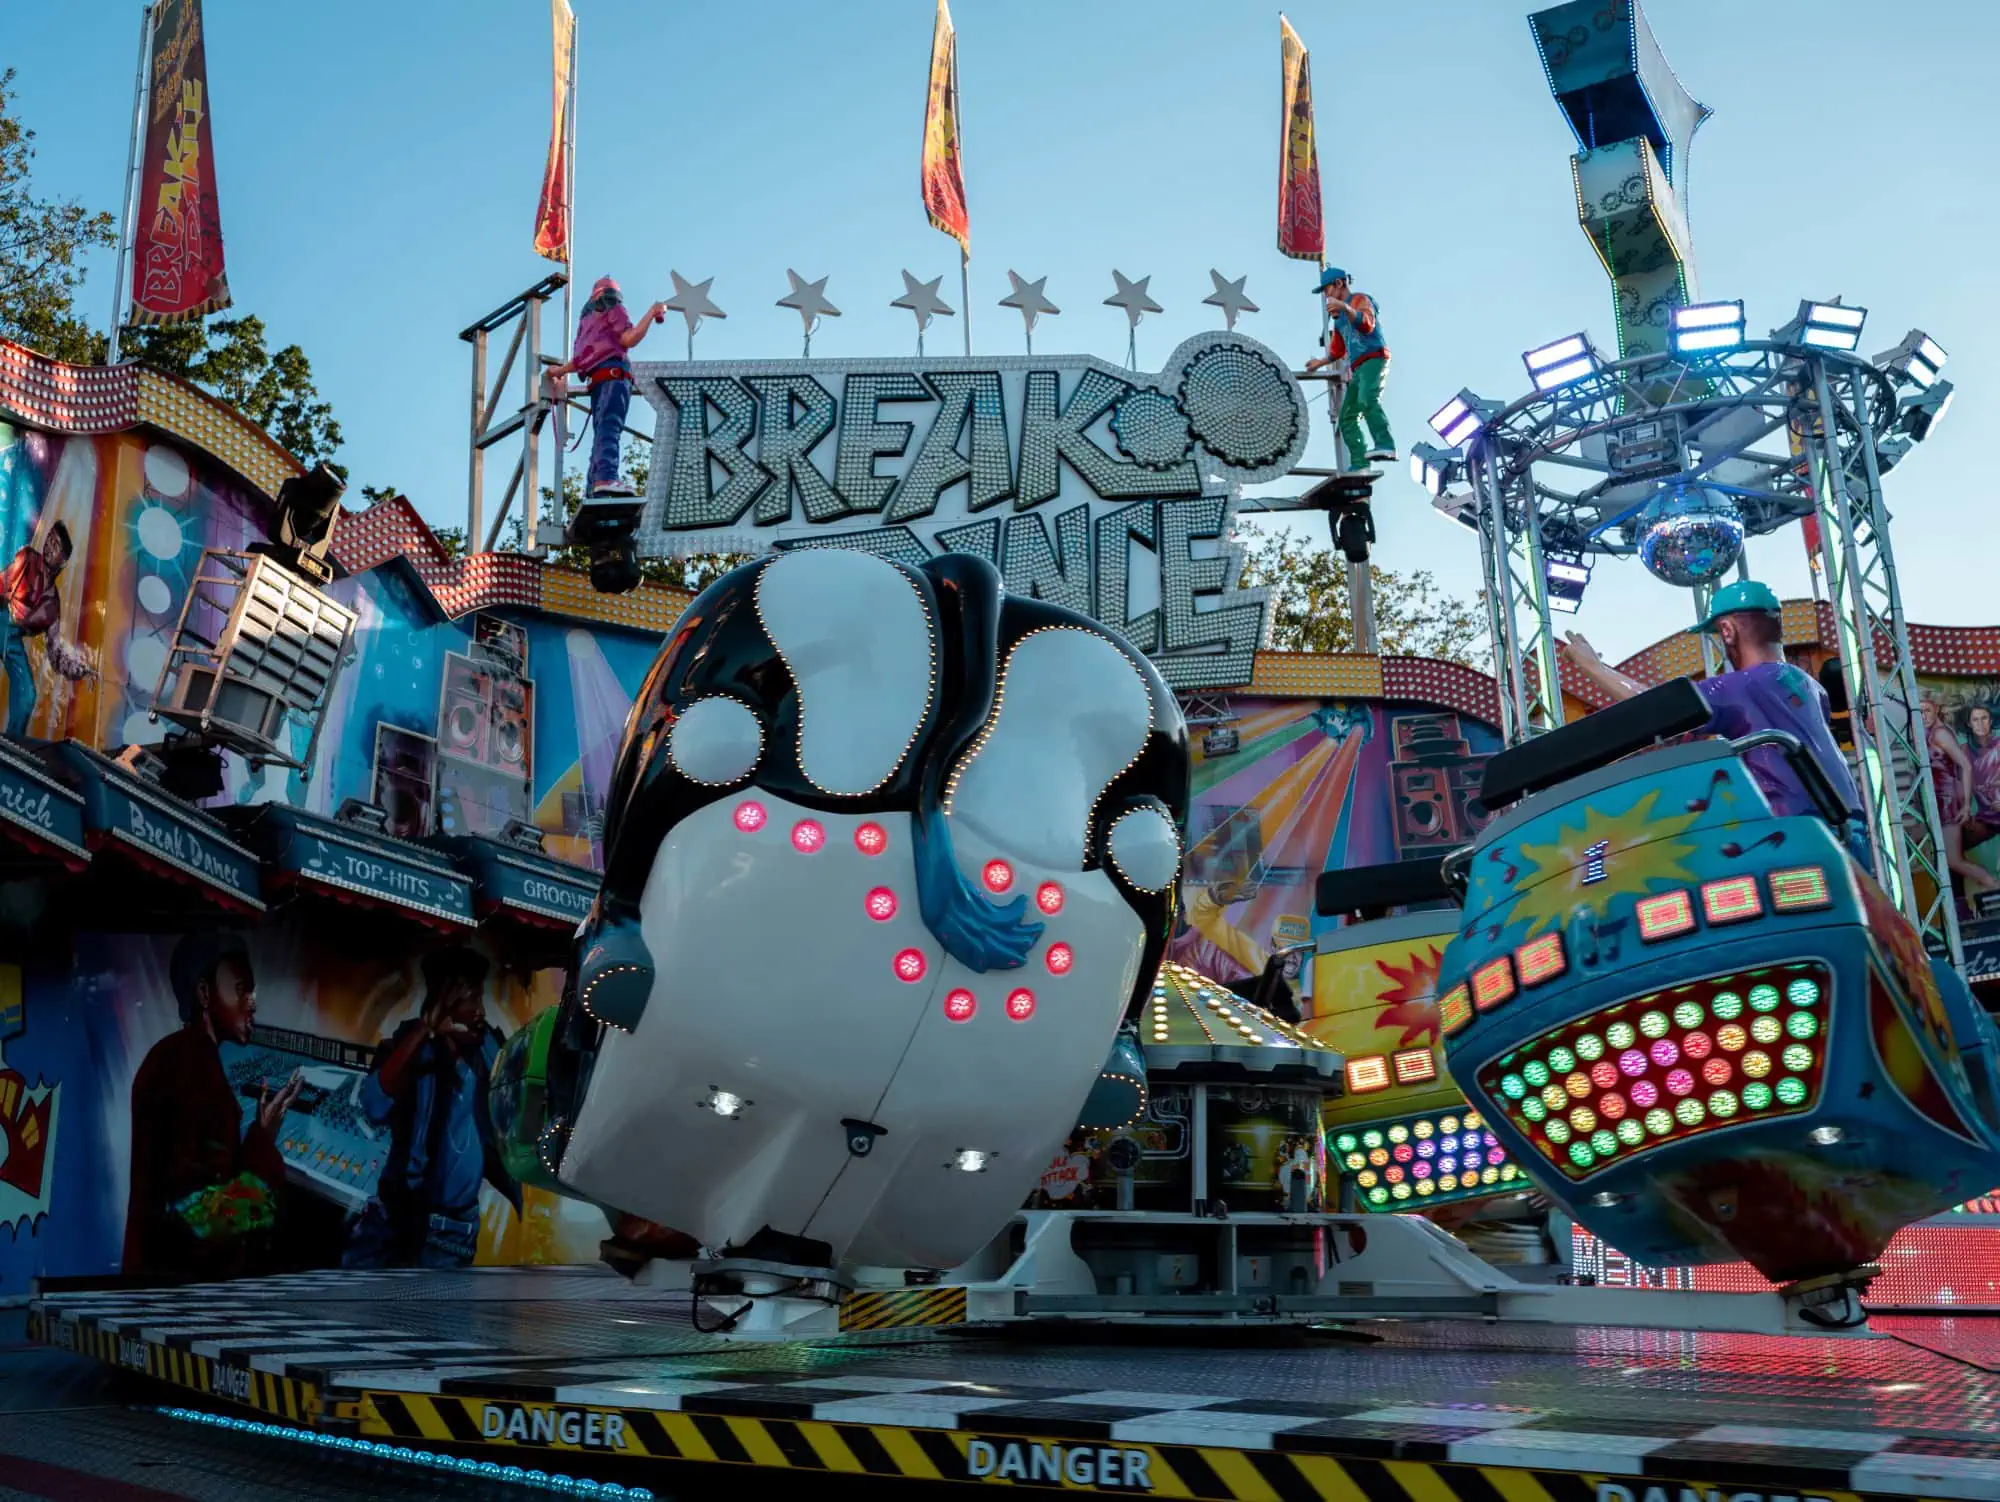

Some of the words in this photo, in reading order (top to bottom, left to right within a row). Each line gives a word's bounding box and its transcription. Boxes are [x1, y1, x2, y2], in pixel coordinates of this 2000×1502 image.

[141, 127, 184, 304] BREAK
[656, 367, 1202, 530] BREAK
[772, 493, 1265, 690] NCE
[128, 800, 185, 858] Break
[187, 832, 241, 888] Dance
[344, 855, 430, 898] TOP-HITS
[1582, 840, 1609, 885] 1
[482, 1404, 627, 1449] DANGER
[968, 1440, 1153, 1488] DANGER
